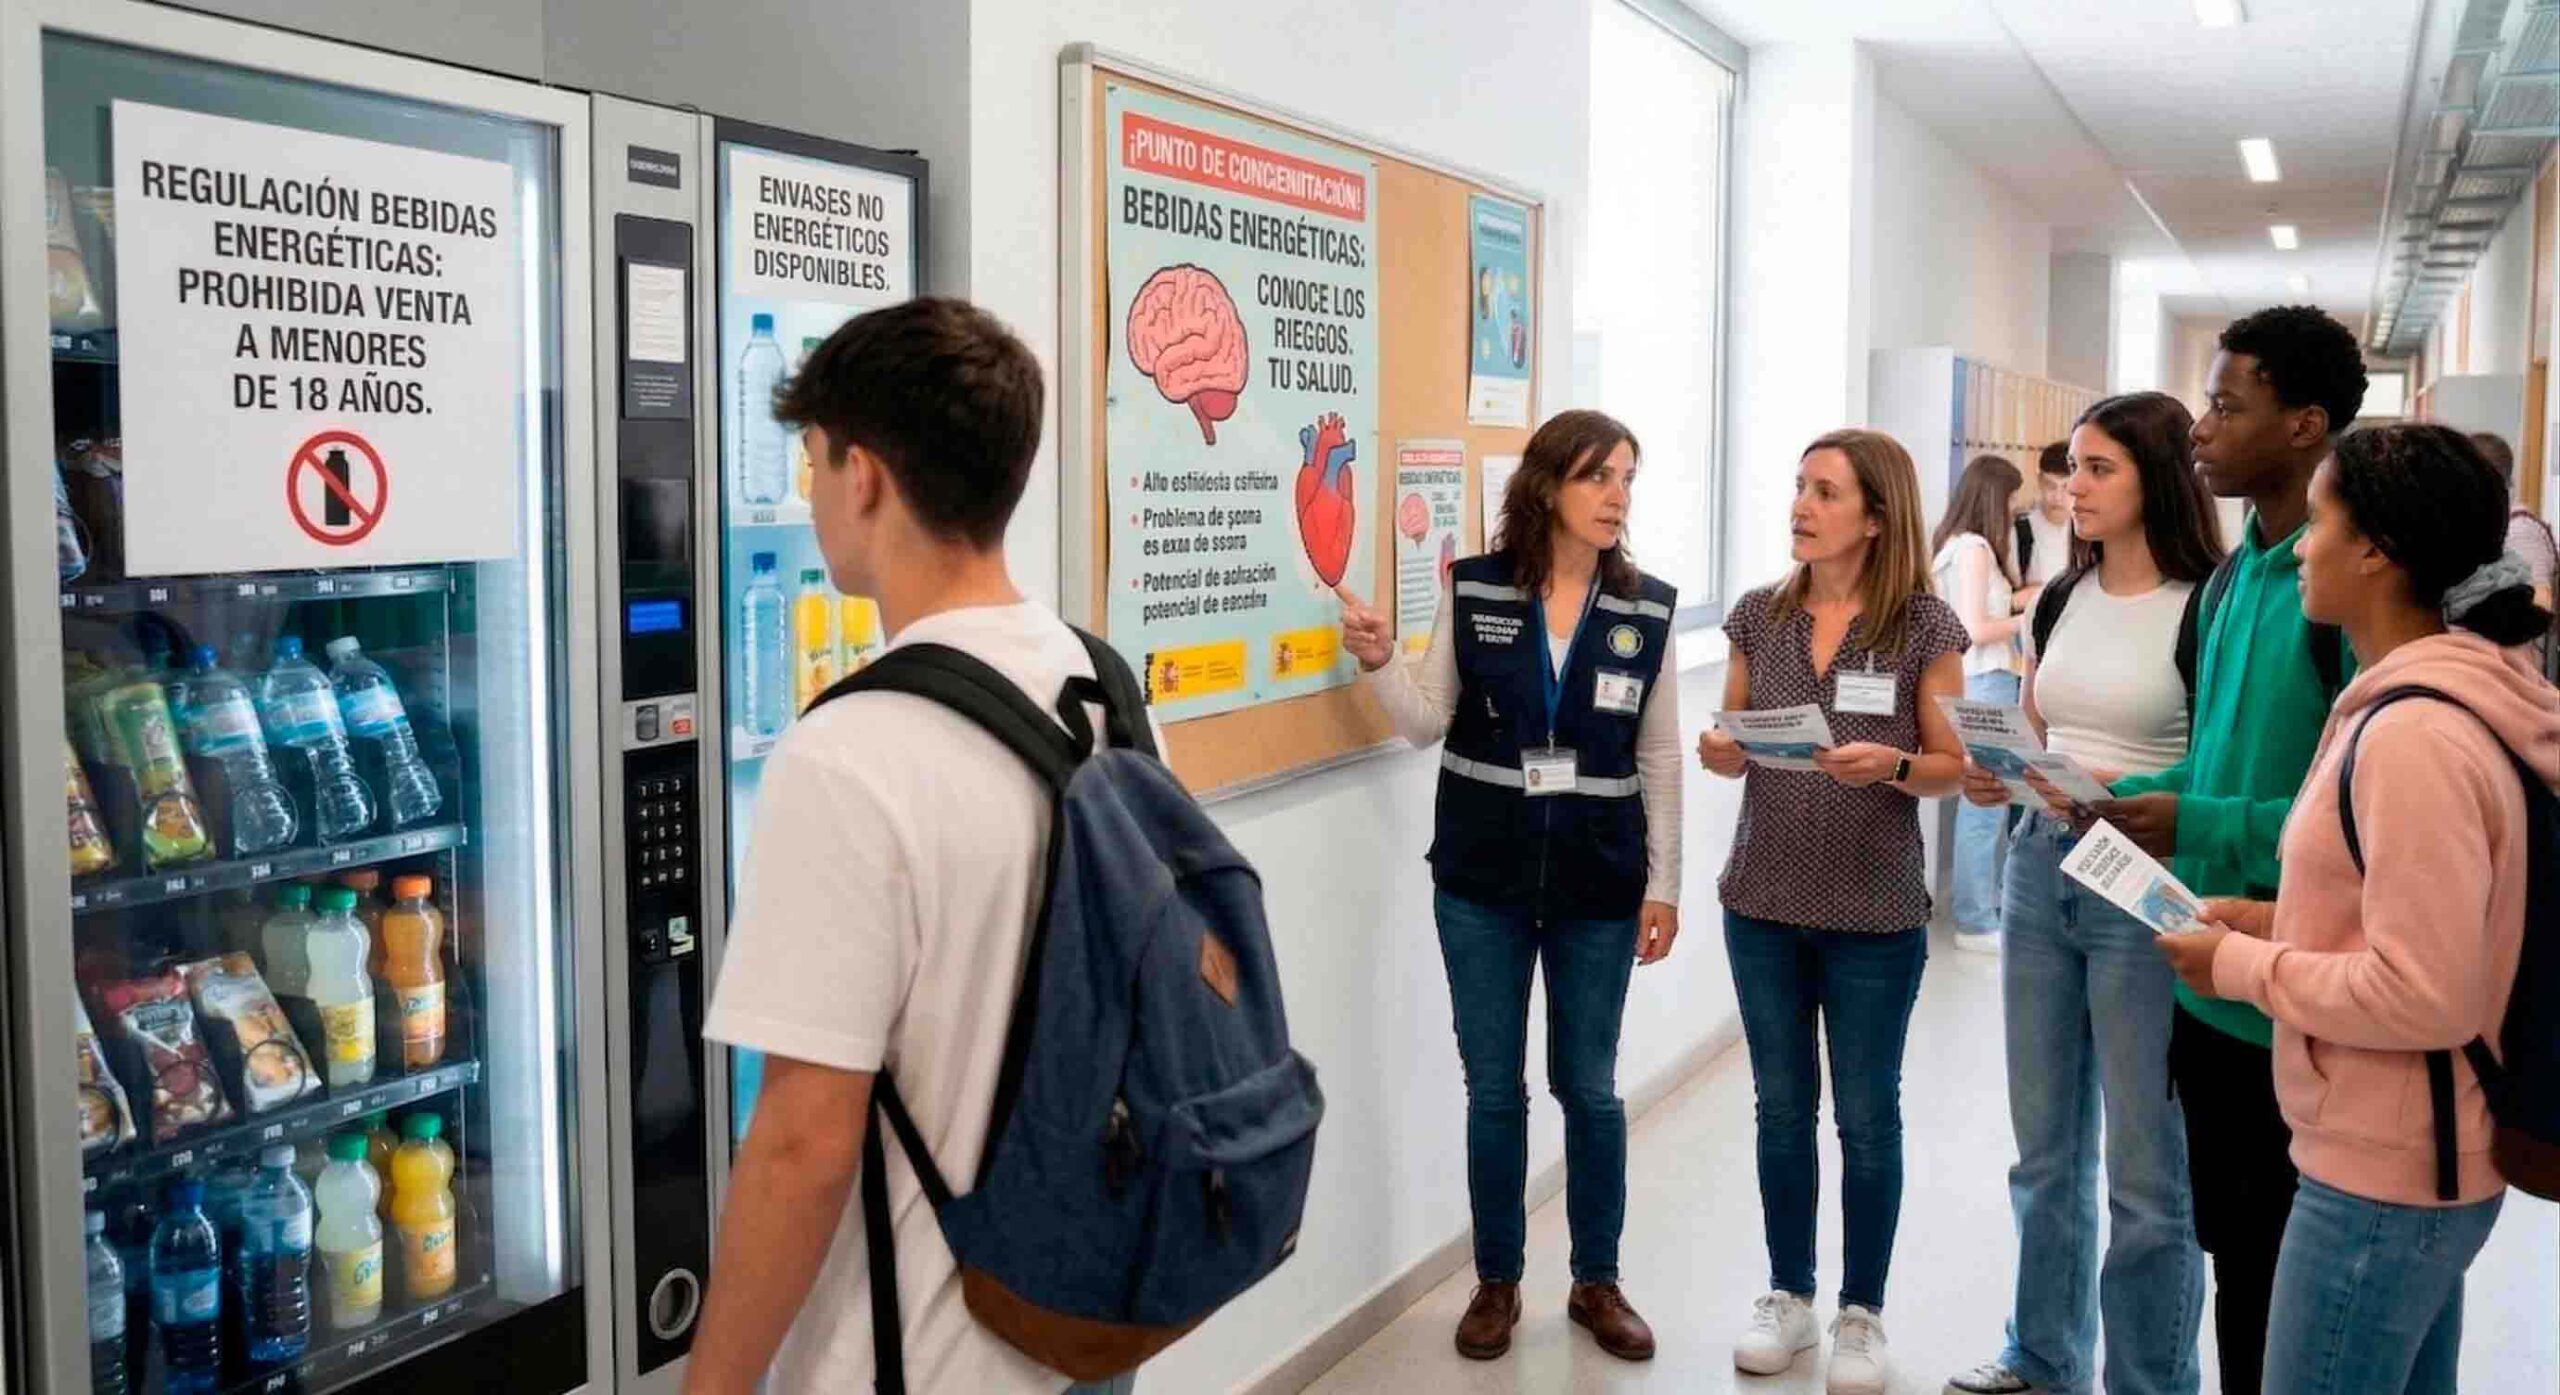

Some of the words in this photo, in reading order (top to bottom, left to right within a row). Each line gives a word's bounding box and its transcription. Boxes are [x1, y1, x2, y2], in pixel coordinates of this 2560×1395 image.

[1129, 128, 1197, 171] ¡PUNTO
[1202, 145, 1226, 178] DE
[142, 160, 360, 223] REGULACIÓN
[371, 193, 498, 239] BEBIDAS
[760, 175, 852, 216] ENVASES
[857, 193, 884, 222] NO
[754, 212, 890, 257] ENERGÉTICOS
[1123, 185, 1223, 241] BEBIDAS
[1230, 208, 1366, 268] ENERGÉTICAS:
[214, 221, 444, 278] ENERGÉTICAS:
[754, 249, 891, 292] DISPONIBLES.
[178, 268, 365, 319] PROHIBIDA
[376, 287, 473, 326] VENTA
[1257, 274, 1330, 315] CONOCE
[1334, 286, 1365, 320] LOS
[235, 324, 259, 360] A
[270, 327, 427, 369] MENORES
[234, 374, 277, 410] DE
[289, 376, 328, 411] 18
[339, 371, 433, 415] AÑOS.
[1268, 357, 1292, 390] TU
[1297, 361, 1357, 395] SALUD.
[1143, 506, 1205, 529] Problema
[1208, 505, 1224, 526] de
[1143, 538, 1160, 556] es
[1193, 532, 1210, 553] de
[1143, 568, 1202, 593] Potencial
[1205, 566, 1221, 587] de
[1143, 595, 1201, 626] potencial
[1203, 593, 1219, 614] de
